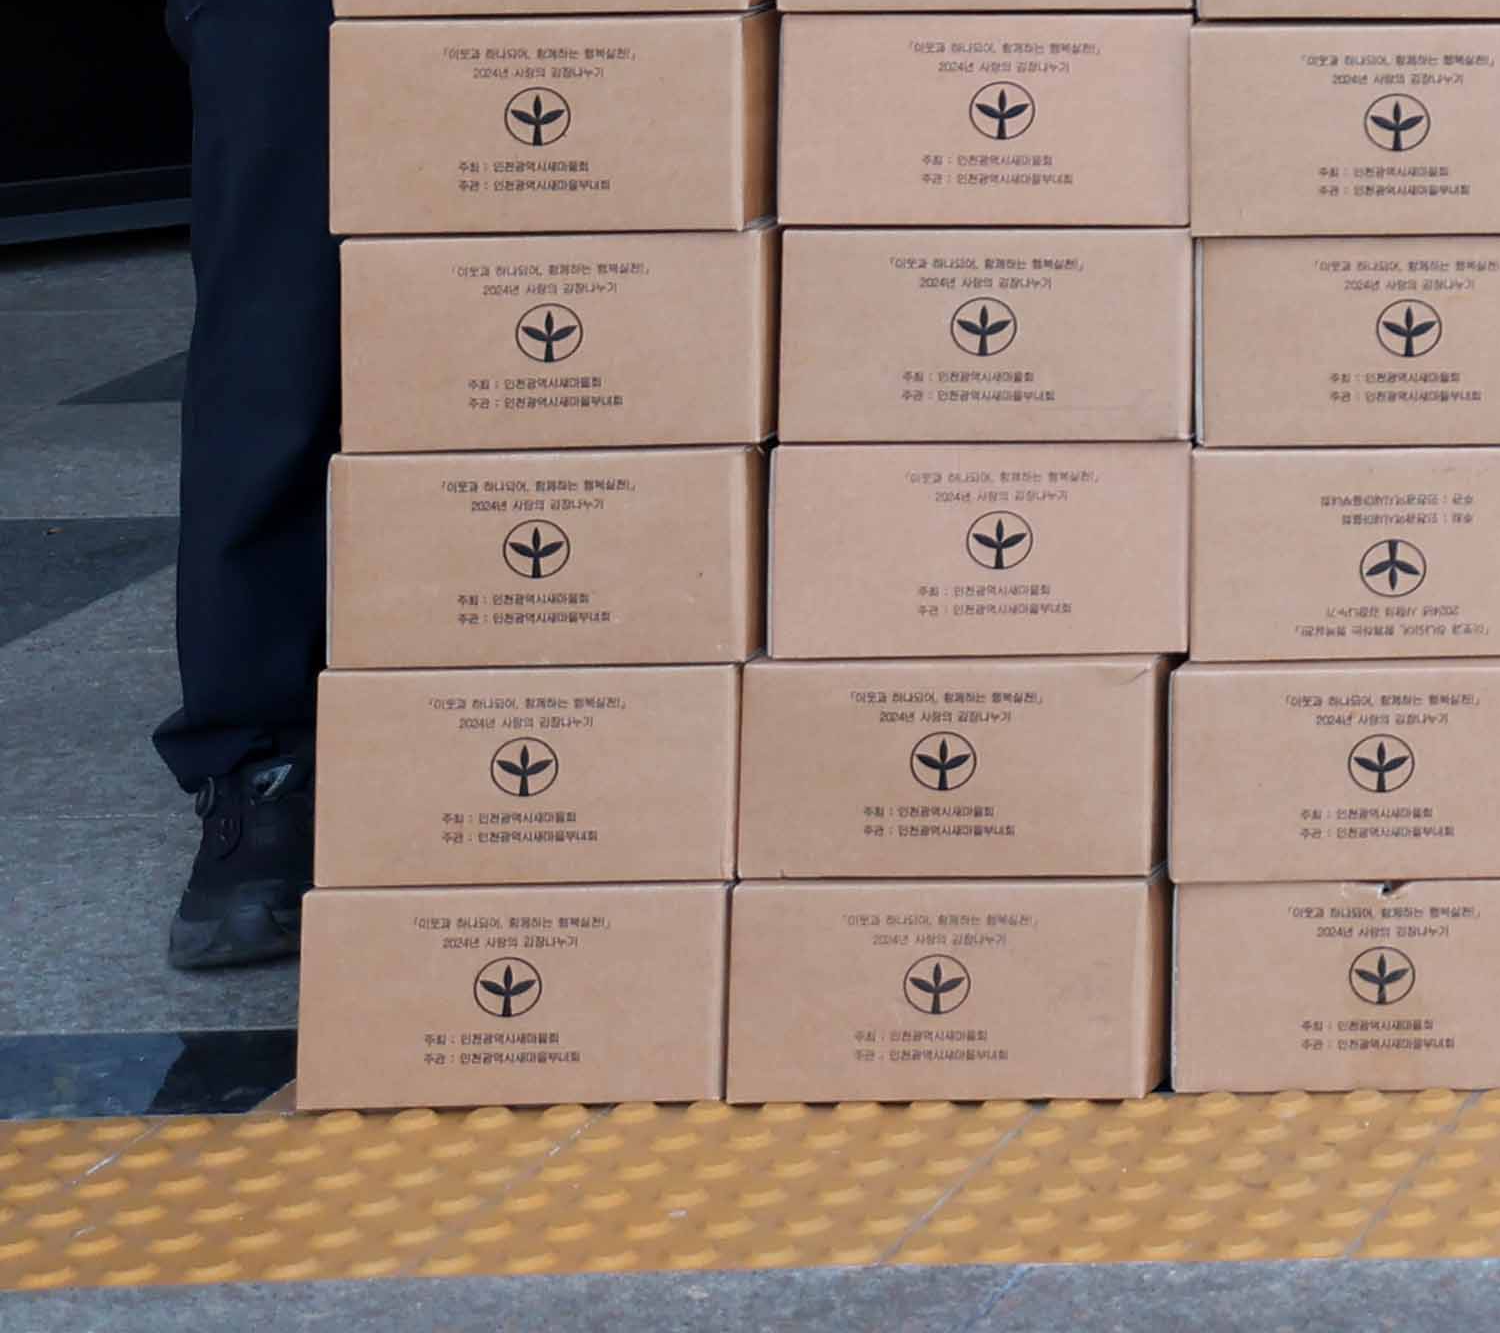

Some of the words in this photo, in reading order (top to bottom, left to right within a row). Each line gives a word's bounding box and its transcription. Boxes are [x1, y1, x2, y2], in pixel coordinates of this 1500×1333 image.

[1379, 693, 1423, 706] 함께하는
[1315, 713, 1354, 726] 2024년
[1357, 713, 1391, 726] 사랑의
[1394, 712, 1450, 725] 김장나누기
[1335, 806, 1434, 820] 인천광역시새마을회
[1335, 825, 1455, 839] 인천광역시새마을부녀회
